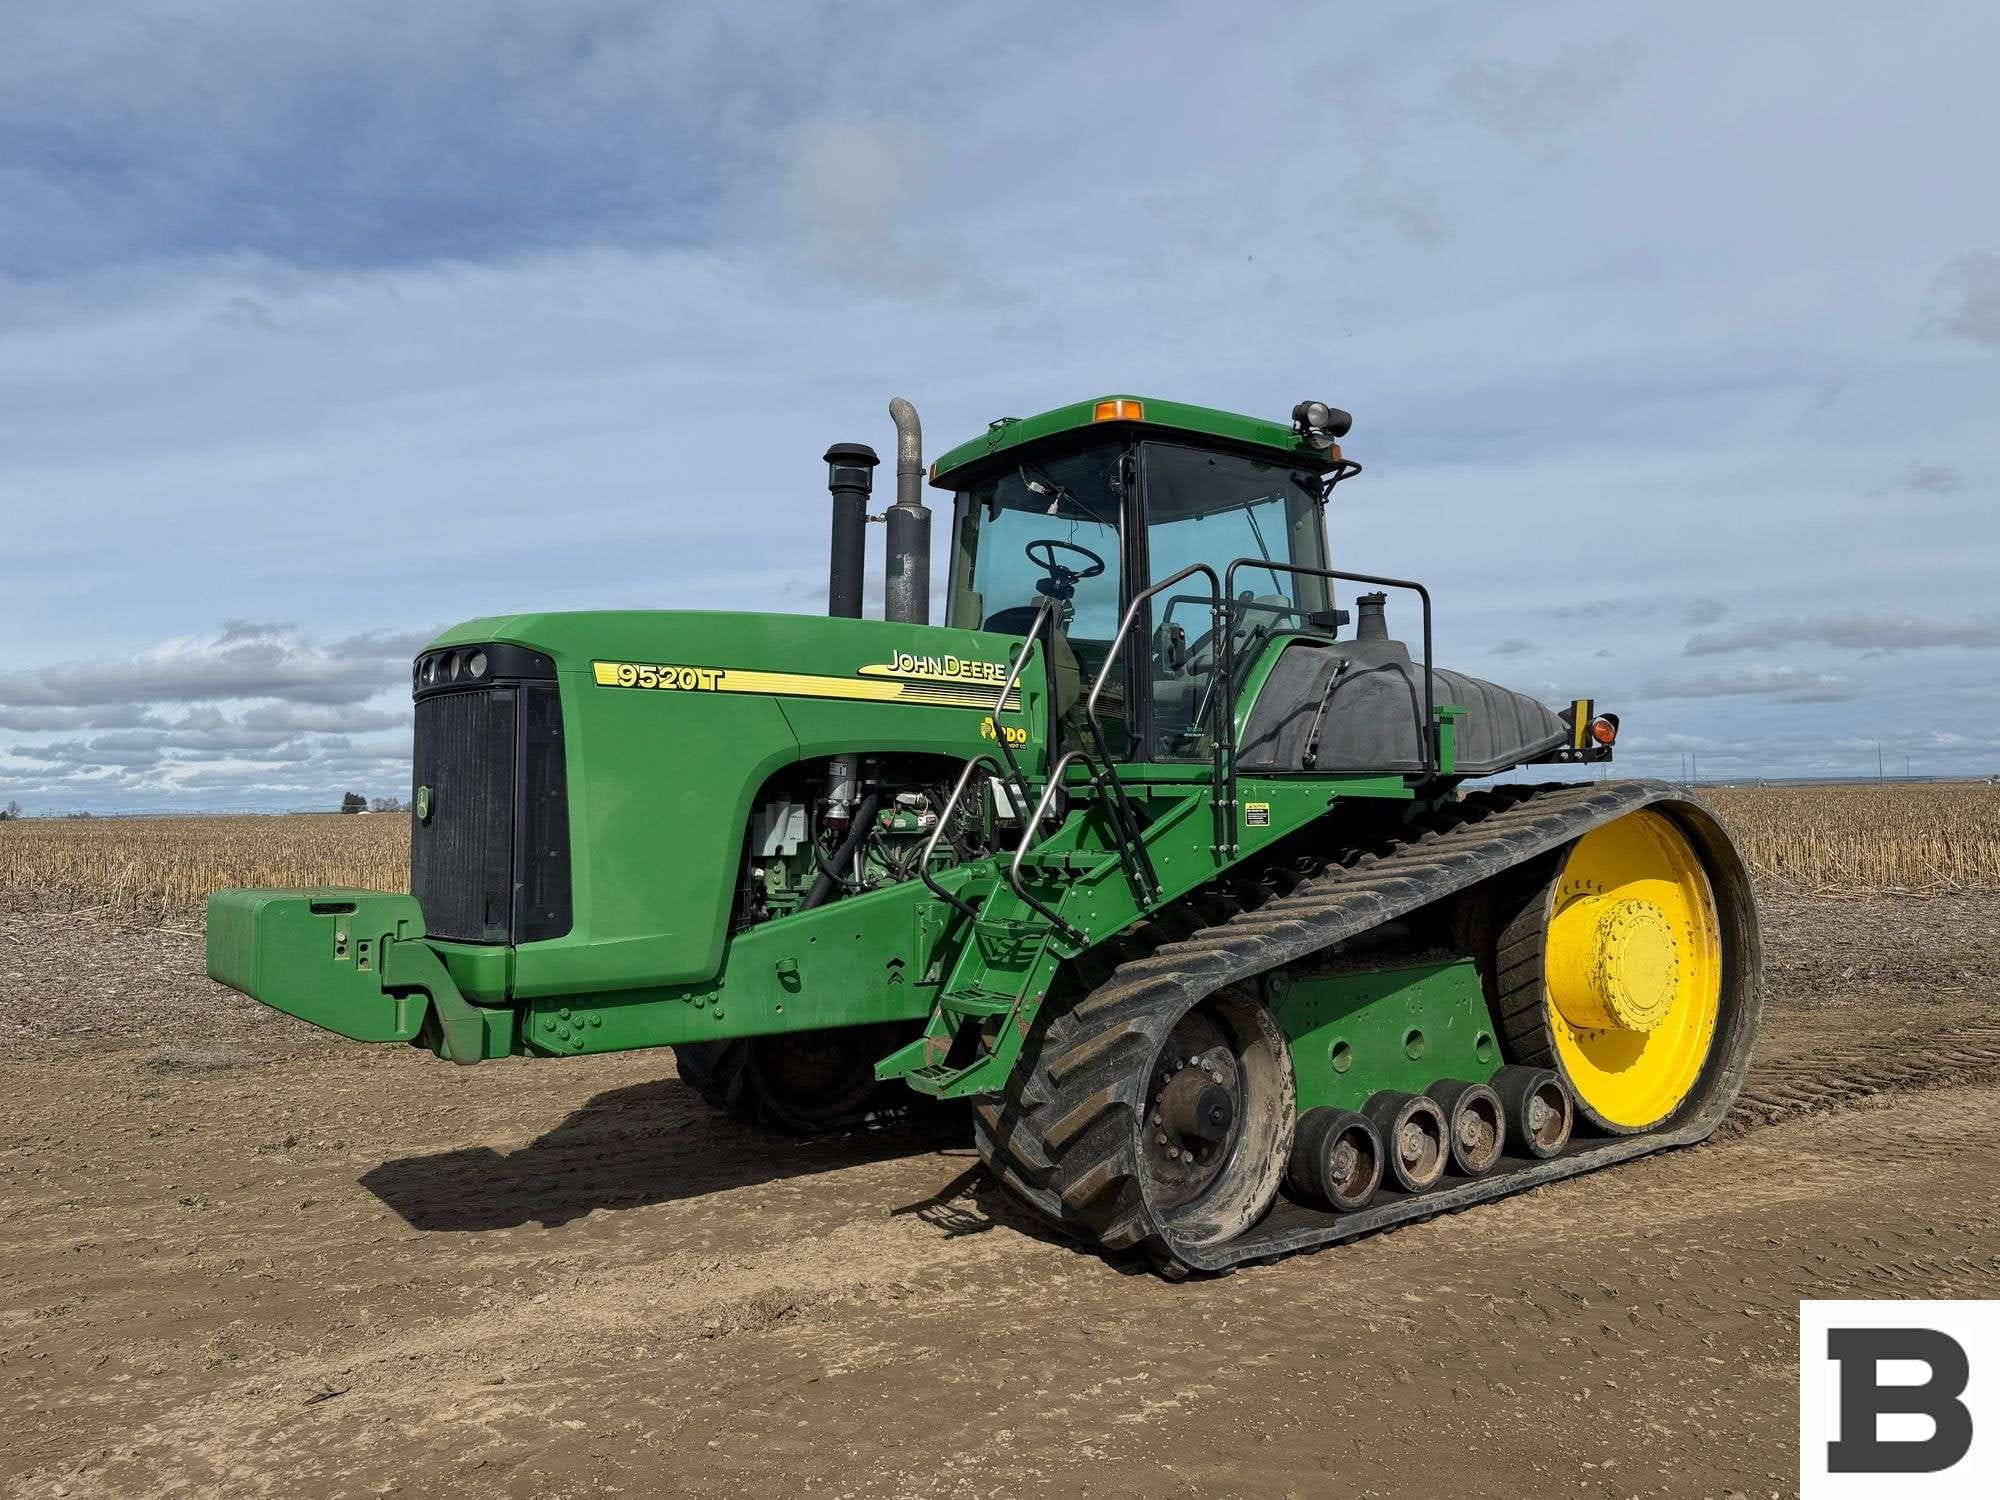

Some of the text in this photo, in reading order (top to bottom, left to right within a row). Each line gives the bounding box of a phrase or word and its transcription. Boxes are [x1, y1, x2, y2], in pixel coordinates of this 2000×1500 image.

[617, 664, 725, 691] 9520T
[887, 650, 1006, 680] JOHN DEERE
